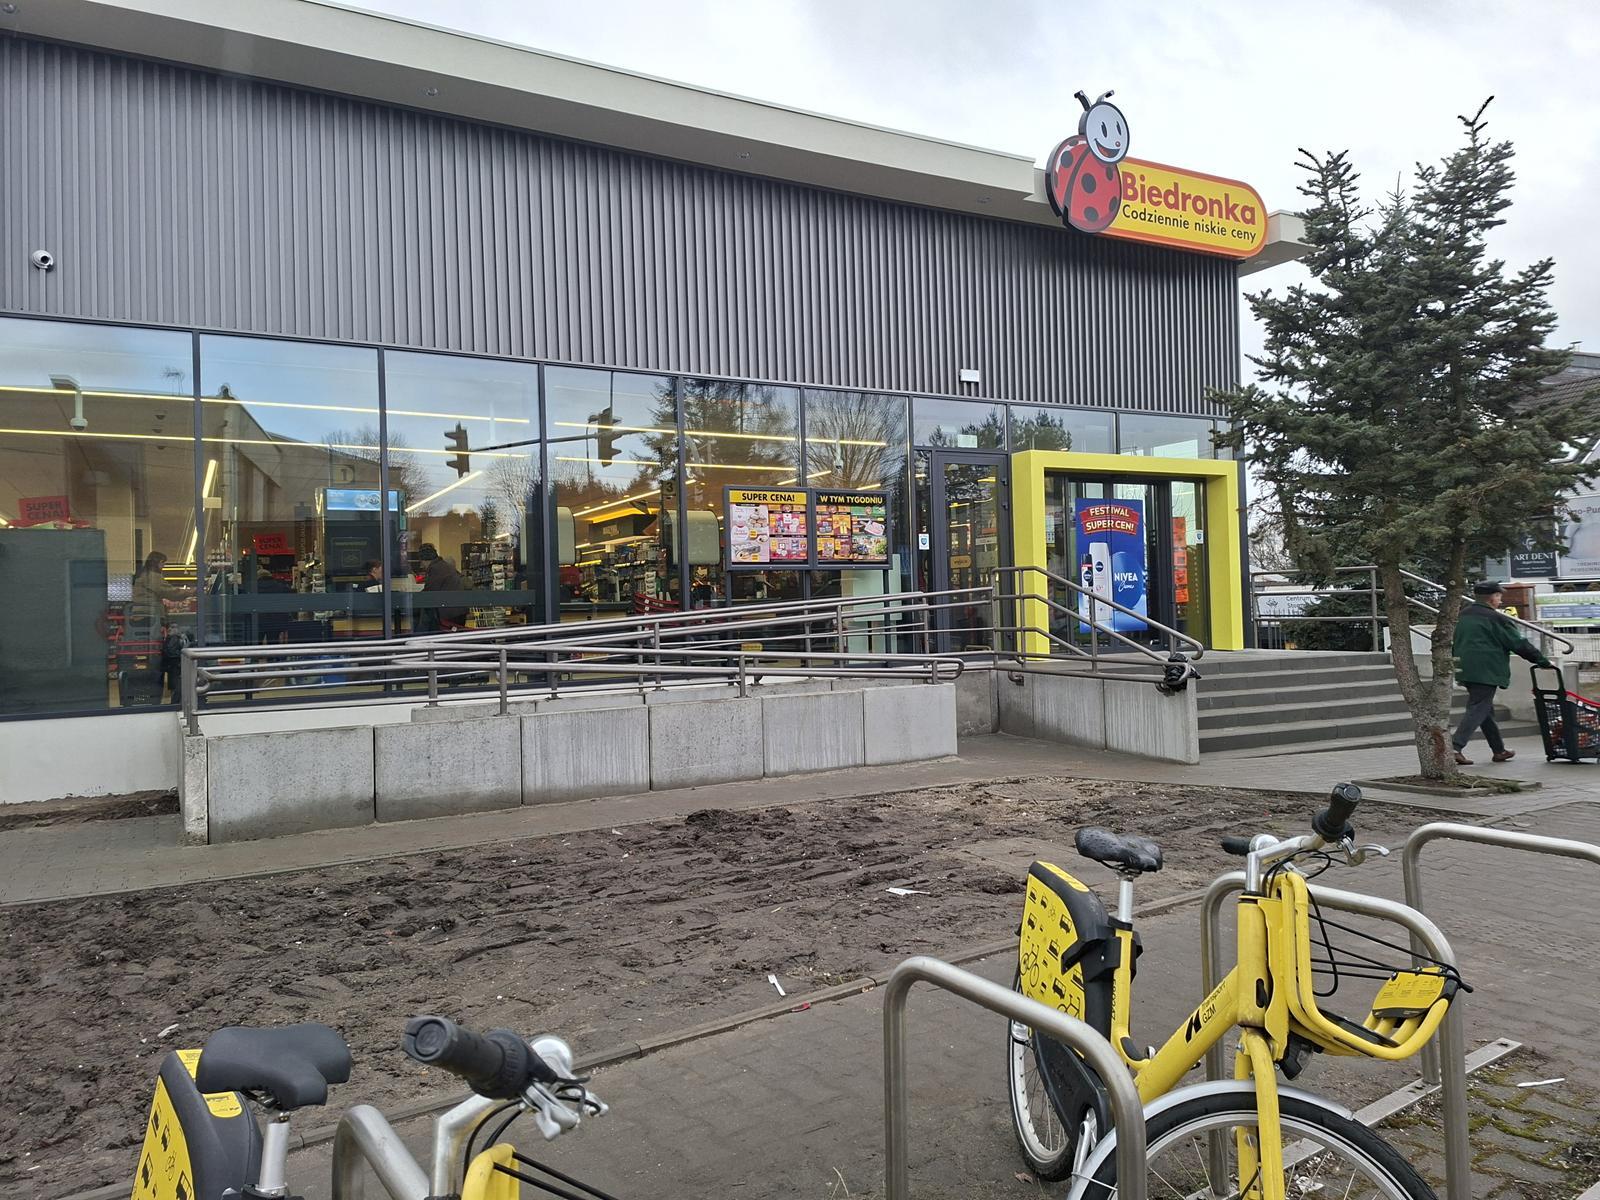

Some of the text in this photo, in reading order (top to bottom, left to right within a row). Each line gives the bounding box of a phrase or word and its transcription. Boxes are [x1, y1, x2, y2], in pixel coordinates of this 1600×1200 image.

[1121, 171, 1256, 225] Biedronka
[1122, 204, 1257, 243] Codziennie niskie ceny
[666, 481, 674, 492] 3
[742, 493, 795, 502] SUPER CENA!
[820, 495, 883, 504] W TYM TYGODNIU
[1089, 506, 1130, 517] FESTIWAL
[1085, 519, 1135, 531] SUPER CEN!
[1531, 552, 1554, 560] DENT
[1114, 572, 1138, 582] NIVEA
[1202, 1003, 1217, 1024] GZM
